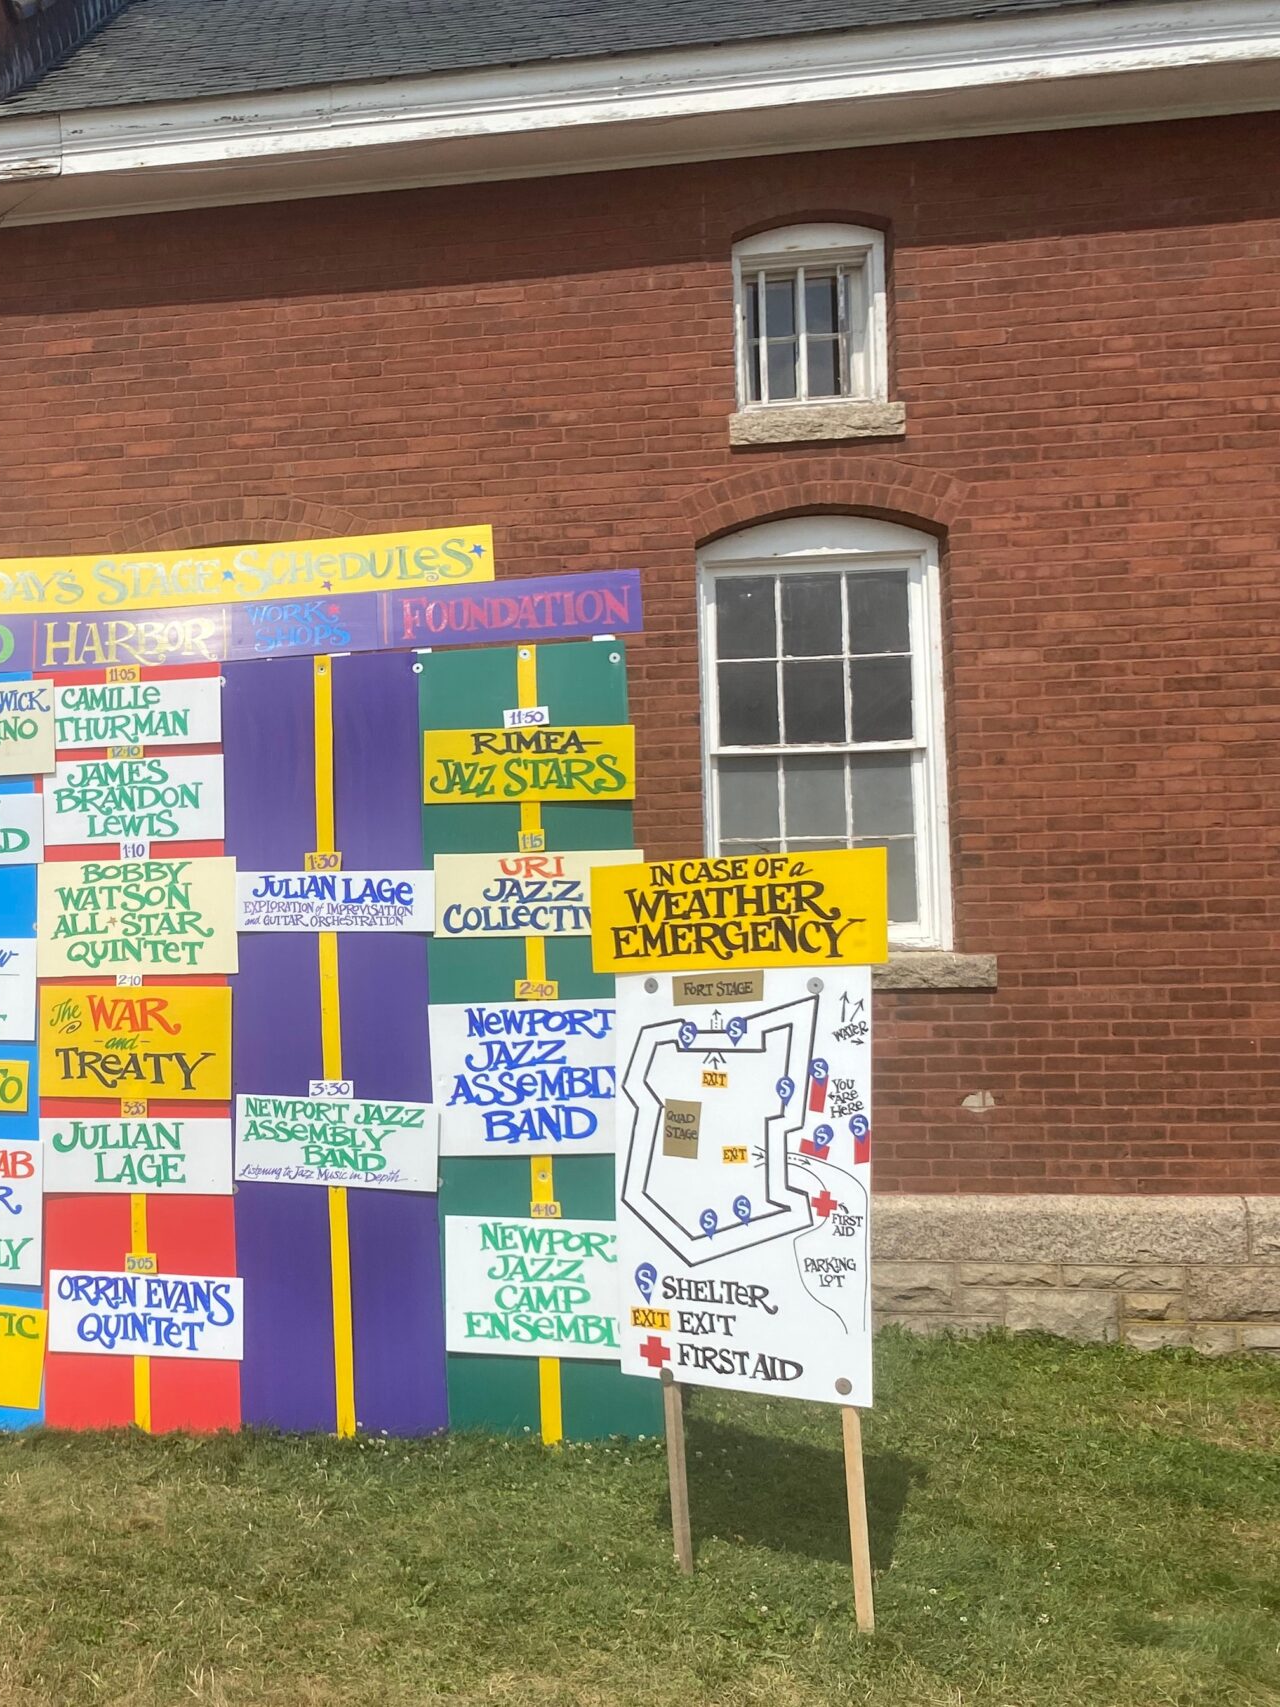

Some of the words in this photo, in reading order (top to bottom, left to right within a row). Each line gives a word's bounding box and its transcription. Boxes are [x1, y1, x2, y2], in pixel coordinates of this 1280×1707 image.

[92, 560, 221, 605] STAGE
[42, 618, 218, 667] HARBOR
[398, 585, 631, 641] FOUNDATION
[242, 601, 328, 625] WORK
[254, 622, 351, 652] SHOPS
[55, 709, 190, 743] THURMAN
[471, 730, 603, 755] RIMEA
[67, 759, 169, 788] JAMES
[430, 759, 498, 797] JAZZ
[503, 754, 626, 797] STARS
[53, 782, 203, 815] BRANDON
[81, 861, 192, 884] BOBBY
[498, 856, 565, 879] URI
[650, 863, 675, 888] IN
[680, 858, 748, 884] CASE
[754, 858, 788, 878] OF
[788, 861, 814, 878] a
[54, 882, 192, 912] WATSON
[252, 875, 337, 901] JULIAN
[483, 878, 584, 903] JAZZ
[624, 880, 842, 924] WEATHER
[243, 900, 315, 914] EXPLORATION
[326, 903, 413, 916] IMPROVISATION
[263, 914, 309, 926] GUITAR
[50, 912, 109, 940] ALL
[120, 911, 215, 937] STAR
[610, 915, 866, 960] EMERGENCY
[519, 982, 554, 997] 2:40
[683, 982, 714, 997] FORT
[716, 981, 754, 996] STAGE
[49, 998, 82, 1027] The
[86, 995, 182, 1035] WAR
[465, 1040, 567, 1072] JAZZ
[311, 1082, 350, 1096] 3:30
[702, 1072, 727, 1087] EXIT
[831, 1079, 855, 1092] YOU
[245, 1097, 349, 1125] NEWPORT
[354, 1103, 425, 1128] JAZZ
[481, 1105, 598, 1144] BAND
[666, 1110, 695, 1124] QUAD
[52, 1122, 184, 1153] JULIAN
[301, 1145, 387, 1171] BAND
[723, 1147, 747, 1161] EXIT
[94, 1152, 186, 1187] LAGE
[239, 1163, 285, 1180] Listening
[289, 1165, 314, 1180] Jazz
[317, 1168, 348, 1180] Music
[832, 1213, 863, 1227] FIRST
[832, 1225, 855, 1236] AID
[487, 1254, 585, 1283] JAZZ
[804, 1257, 856, 1273] PARKING
[819, 1274, 845, 1287] LOT
[58, 1275, 141, 1309] ORRIN
[144, 1279, 235, 1326] EVANS
[494, 1285, 591, 1314] CAMP
[632, 1309, 670, 1328] EXIT
[677, 1310, 736, 1337] EXIT
[677, 1343, 750, 1376] FIRST
[749, 1353, 804, 1381] AID
